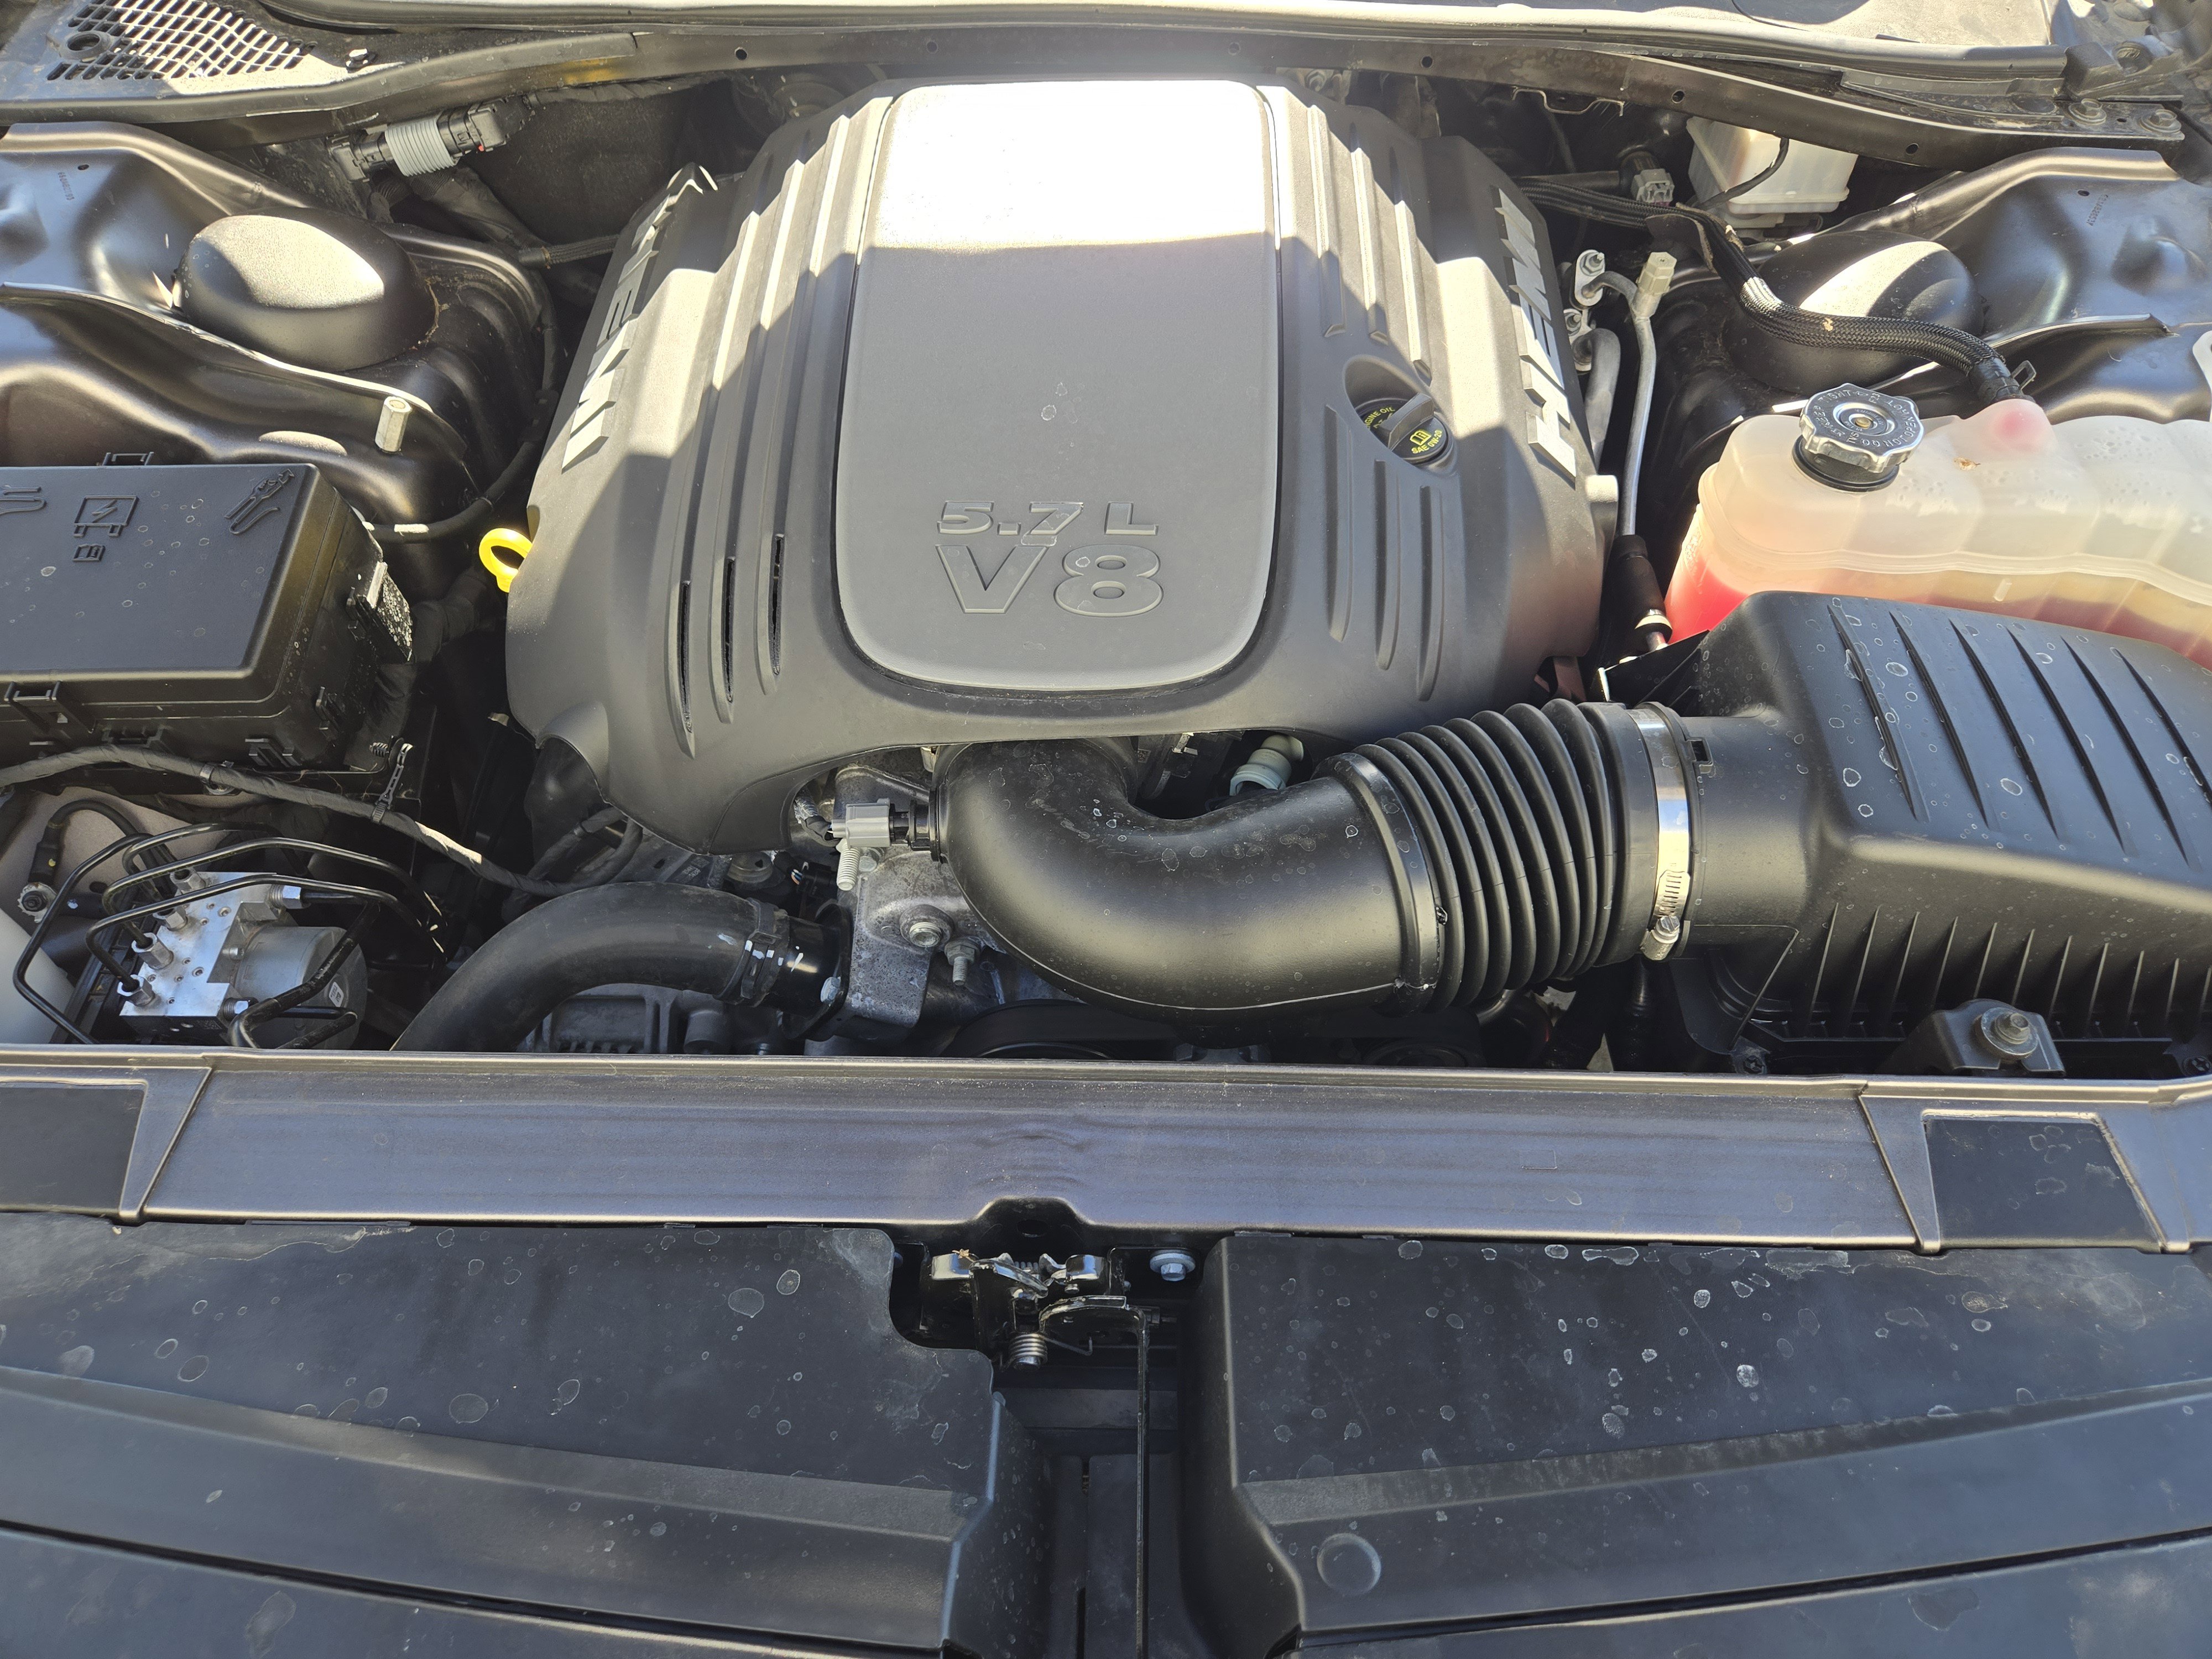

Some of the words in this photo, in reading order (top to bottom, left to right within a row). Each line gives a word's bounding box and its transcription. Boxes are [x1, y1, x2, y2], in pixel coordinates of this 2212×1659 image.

[1869, 393, 1881, 403] F23
[1411, 445, 1429, 454] SAE
[1428, 430, 1442, 447] 0W-20
[1846, 432, 1859, 444] TVS
[1861, 439, 1880, 447] DO
[1883, 435, 1907, 447] NOT
[1905, 416, 1917, 437] OPEN
[937, 500, 1083, 535] 5.7
[1104, 501, 1159, 535] L
[935, 544, 1164, 617] V8
